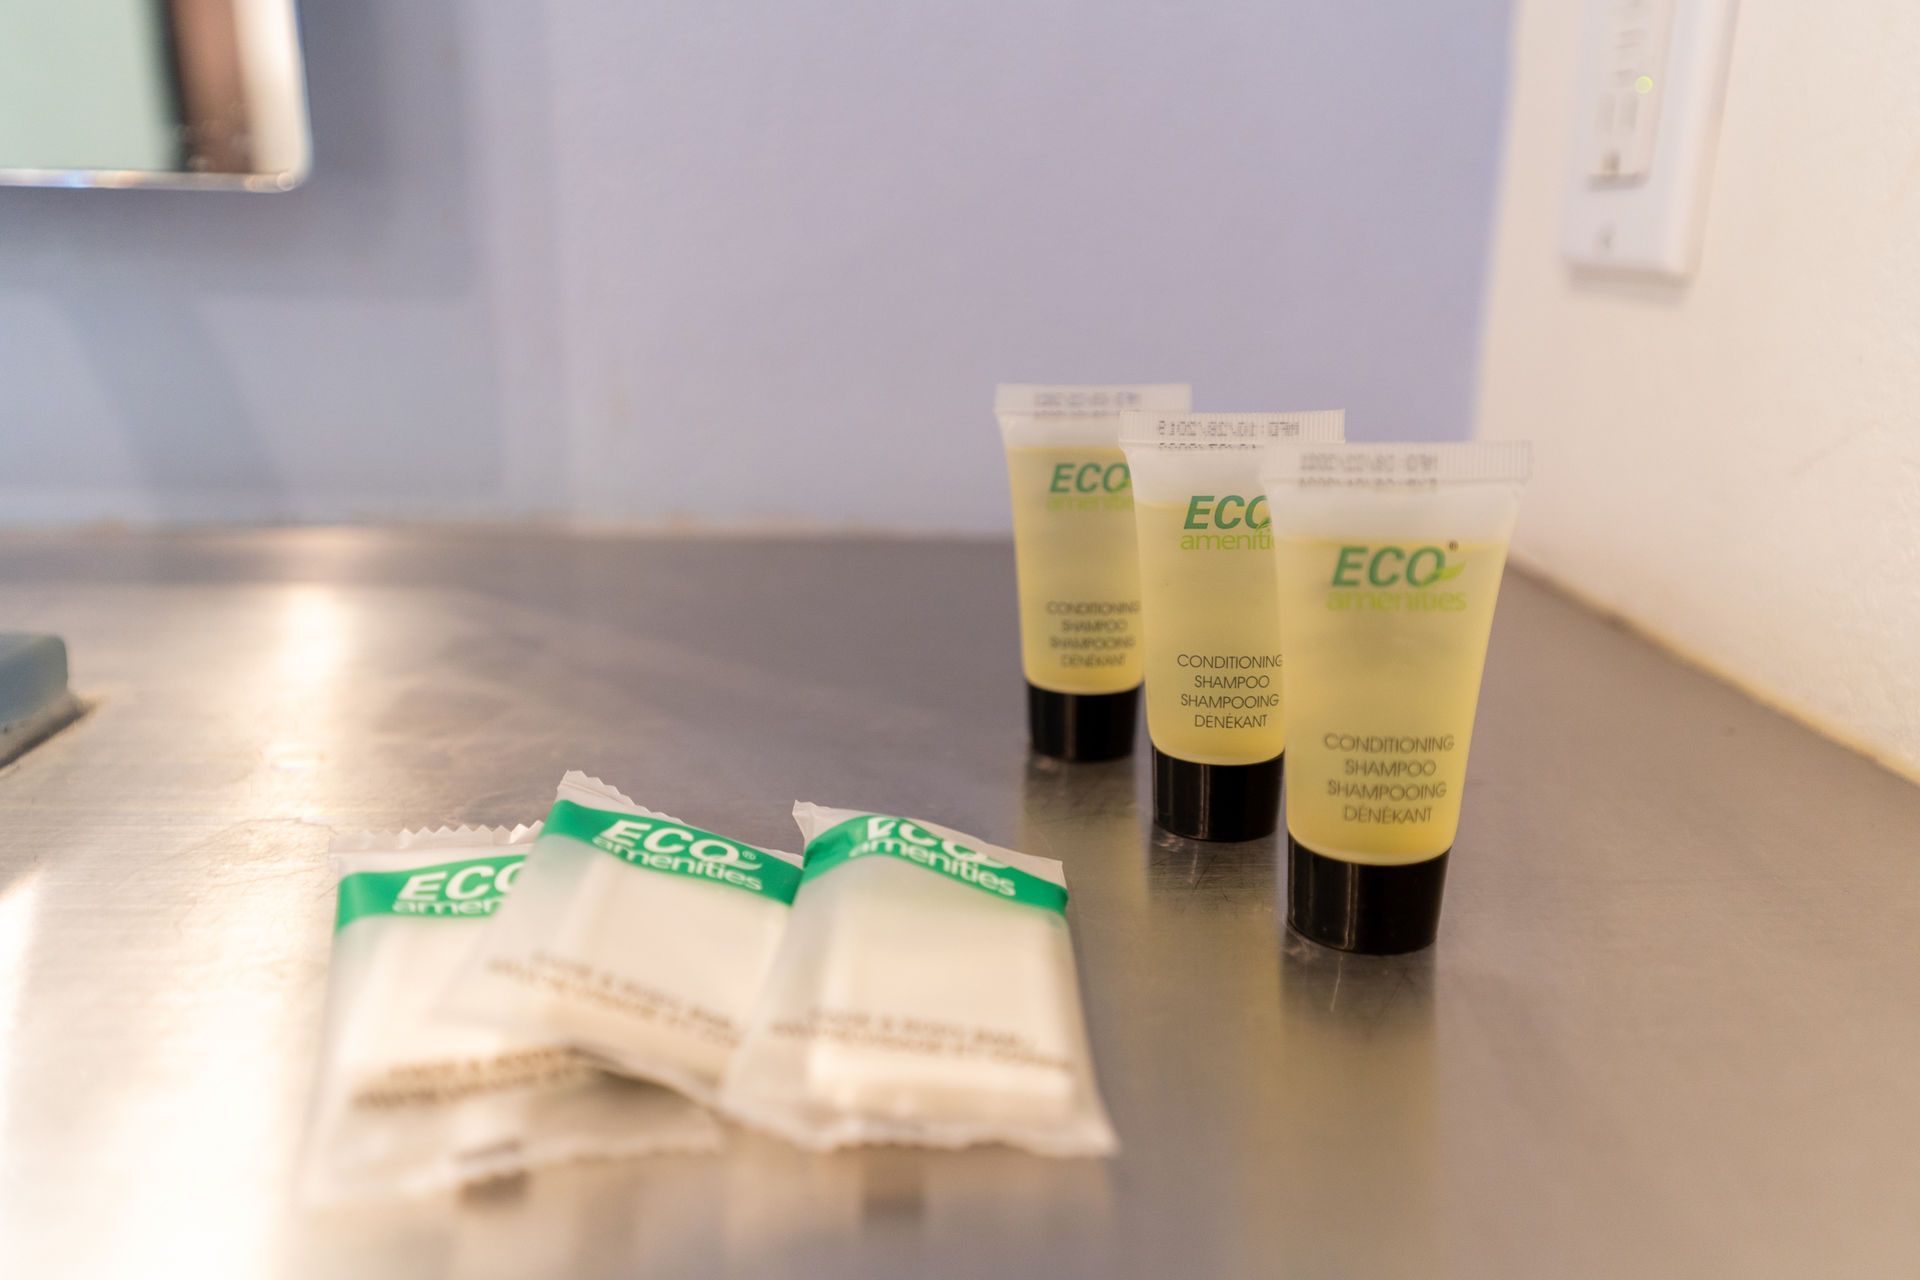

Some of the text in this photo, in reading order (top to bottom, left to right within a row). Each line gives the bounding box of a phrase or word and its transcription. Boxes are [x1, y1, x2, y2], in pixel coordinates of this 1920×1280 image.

[1049, 463, 1132, 493] ECO
[1179, 532, 1274, 550] ameniti
[1331, 546, 1446, 588] ECO
[1325, 591, 1467, 611] amenities
[1061, 619, 1128, 633] SHAMPOO
[1050, 636, 1136, 650] SHAMPOOING
[1176, 654, 1283, 669] CONDITIONING
[1194, 675, 1270, 689] SHAMPOO
[1181, 693, 1280, 709] SHAMPOOING
[1323, 732, 1455, 753] CONDITIONING
[1345, 759, 1437, 777] SHAMPOO
[1327, 779, 1447, 800] SHAMPOOING
[600, 819, 740, 864] ECO
[592, 836, 763, 891] amenities
[848, 837, 1017, 896] amenities
